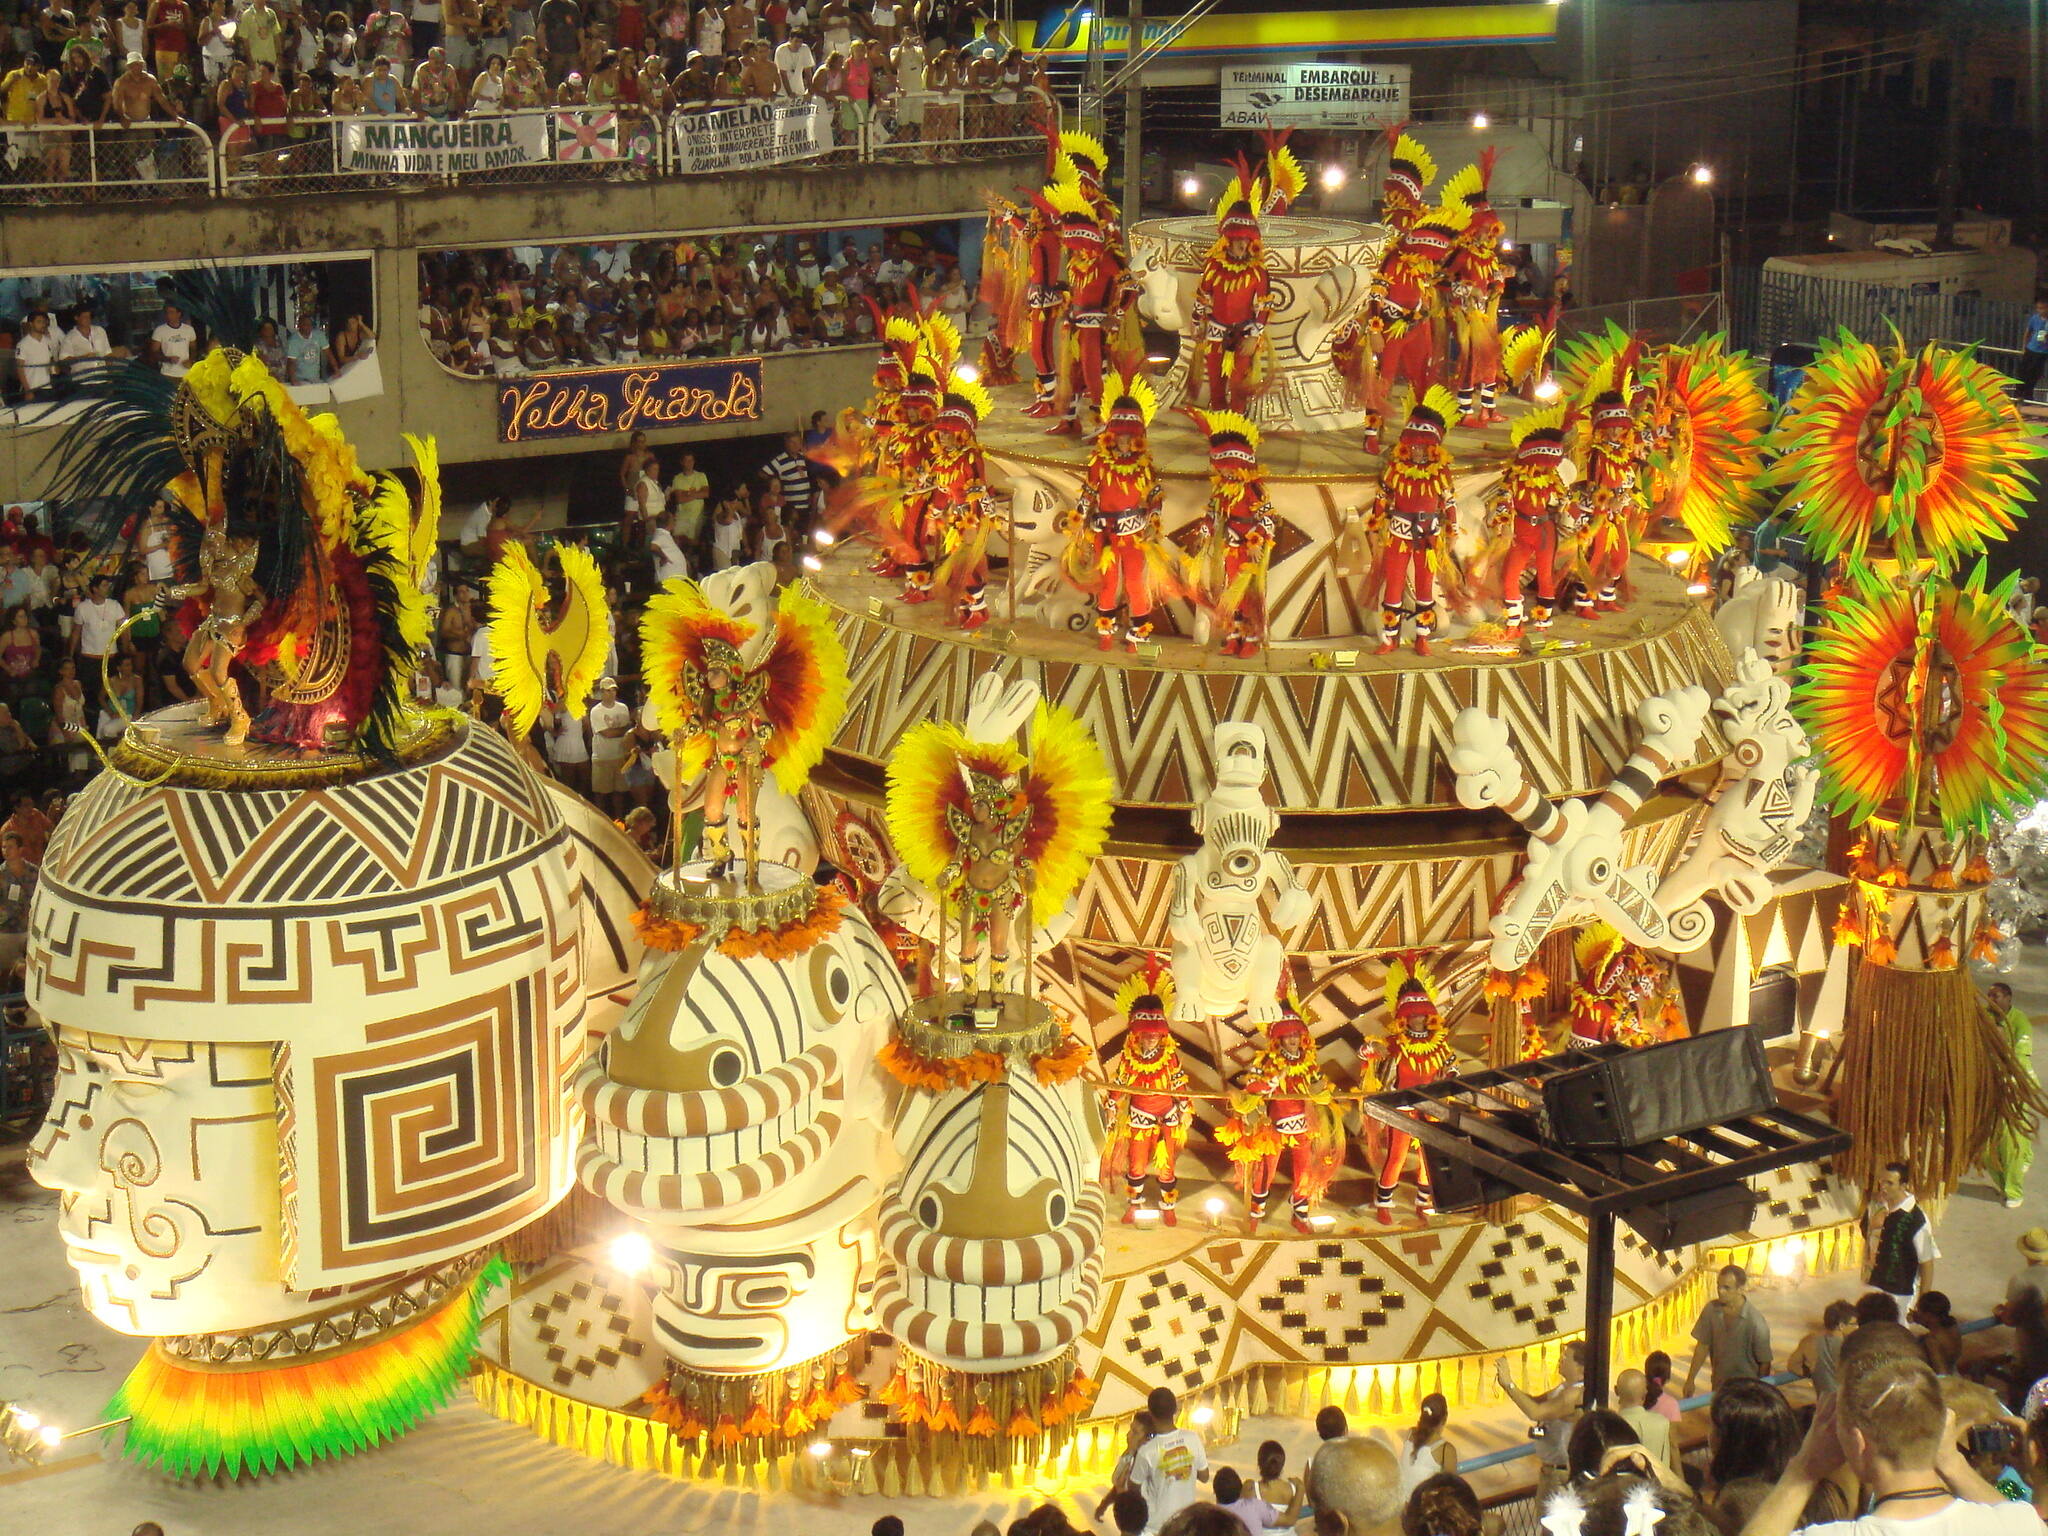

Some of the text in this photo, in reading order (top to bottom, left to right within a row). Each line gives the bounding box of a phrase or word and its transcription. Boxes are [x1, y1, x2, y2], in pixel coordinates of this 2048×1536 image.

[1233, 71, 1287, 83] TERMINAL
[1300, 70, 1378, 85] EMBARQUE
[1295, 87, 1399, 102] DESEMBARQUE
[1225, 111, 1267, 124] ABAV
[364, 122, 513, 149] MANGUEIRA
[720, 123, 775, 142] INTERPRETE
[777, 134, 788, 145] TE
[790, 128, 808, 142] AMA
[350, 151, 399, 171] MINHA
[404, 153, 432, 172] VIDA
[437, 154, 443, 171] E
[449, 152, 478, 171] MEU
[503, 371, 760, 441] Velha Guarda
